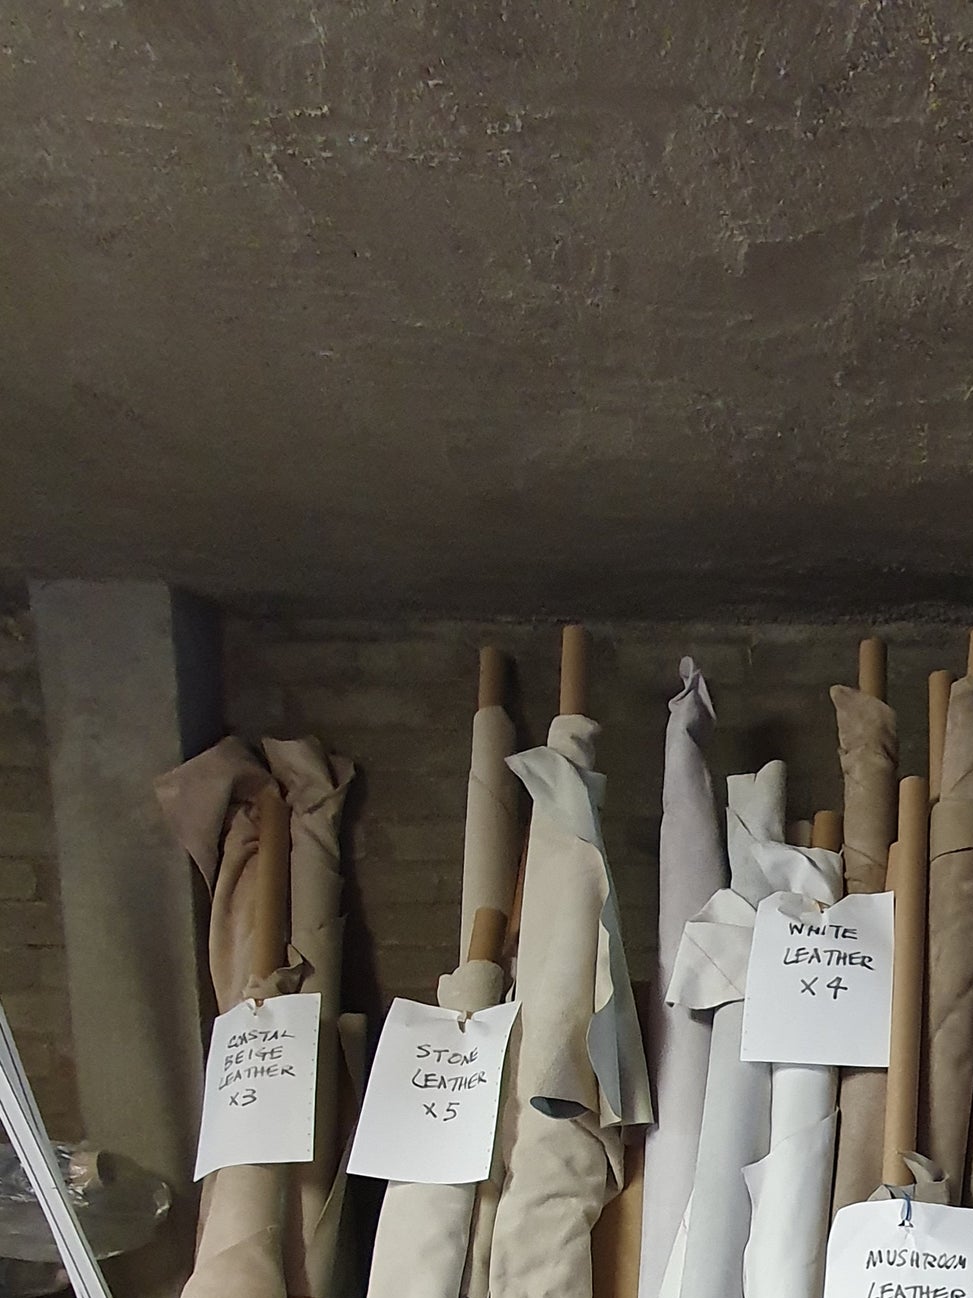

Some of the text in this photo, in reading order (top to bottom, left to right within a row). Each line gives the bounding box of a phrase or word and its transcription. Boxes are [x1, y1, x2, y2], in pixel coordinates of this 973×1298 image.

[789, 922, 858, 940] WHITE
[783, 947, 875, 971] LEATHER
[224, 1045, 283, 1071] BEIGE
[416, 1043, 479, 1065] STONE
[218, 1064, 296, 1090] LEATHER
[411, 1068, 488, 1091] LEATHER
[866, 1249, 967, 1270] MUSHROOM
